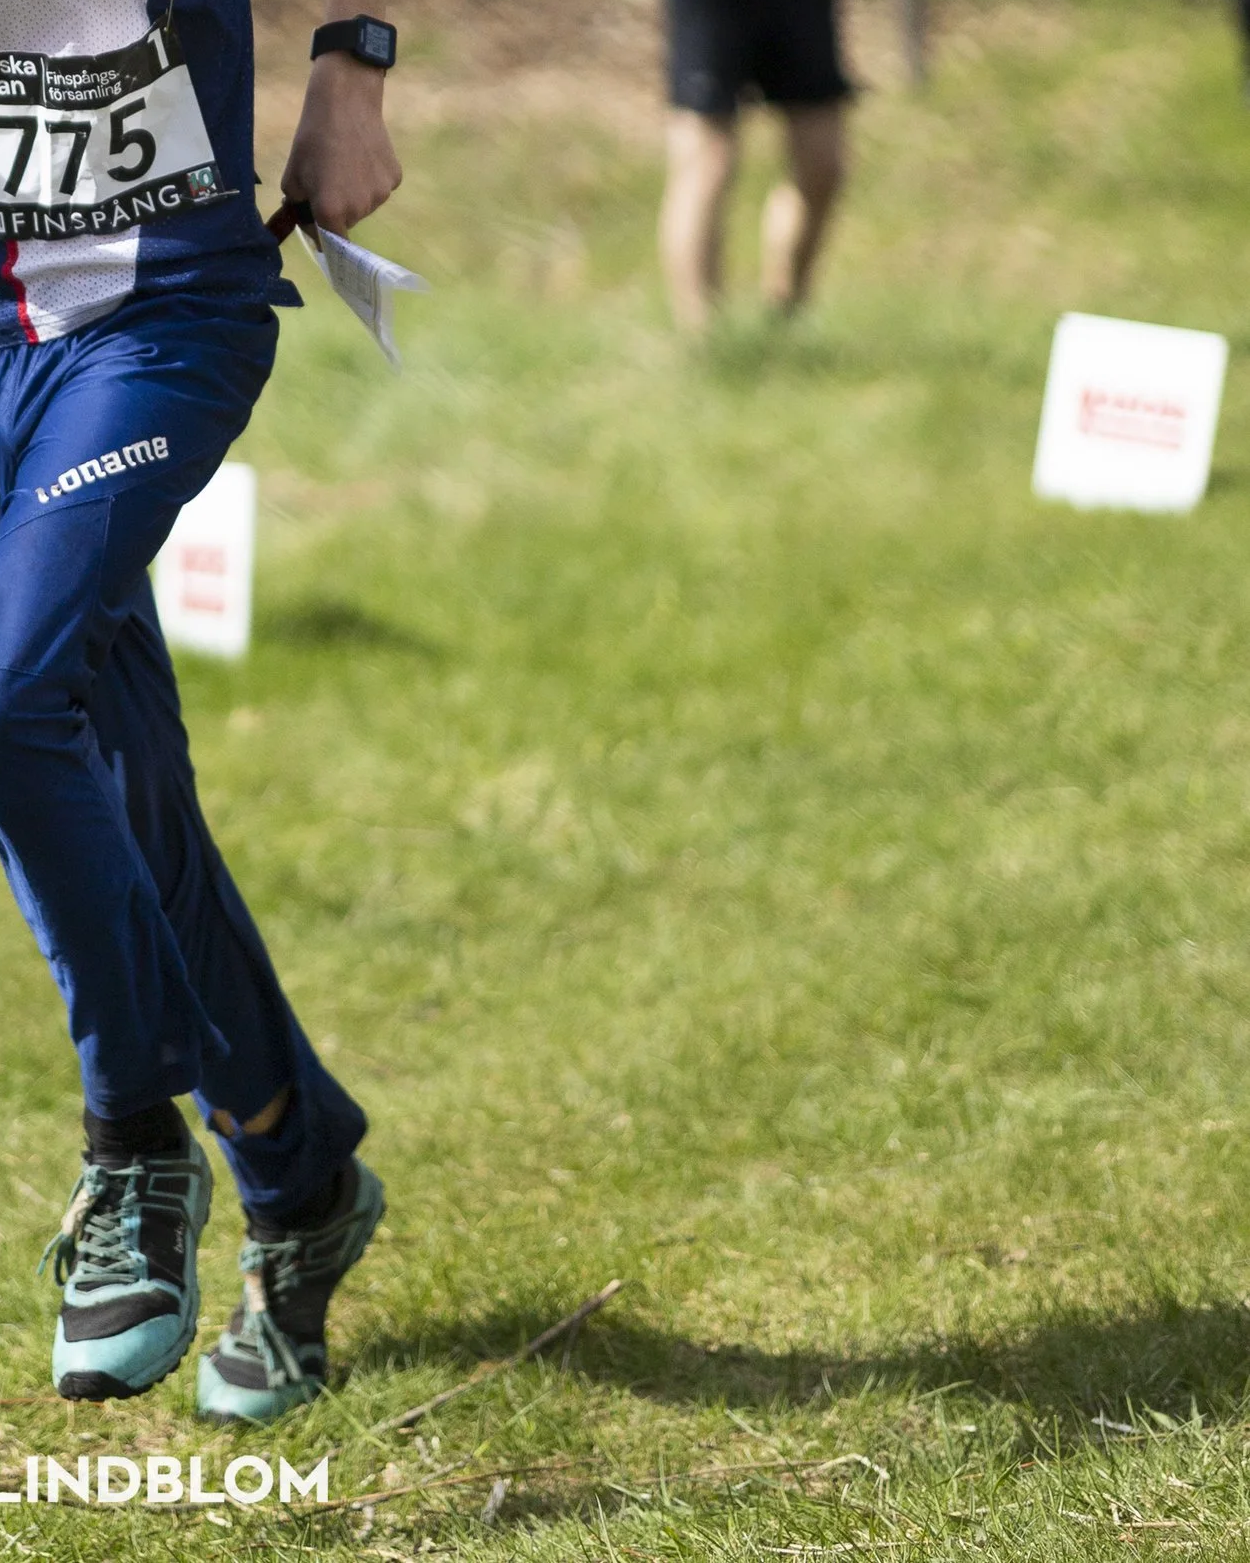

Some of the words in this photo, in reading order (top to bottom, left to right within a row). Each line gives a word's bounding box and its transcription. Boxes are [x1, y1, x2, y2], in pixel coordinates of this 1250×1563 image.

[147, 28, 170, 69] 1
[49, 81, 122, 102] församling
[12, 185, 181, 235] FINSPÅNG
